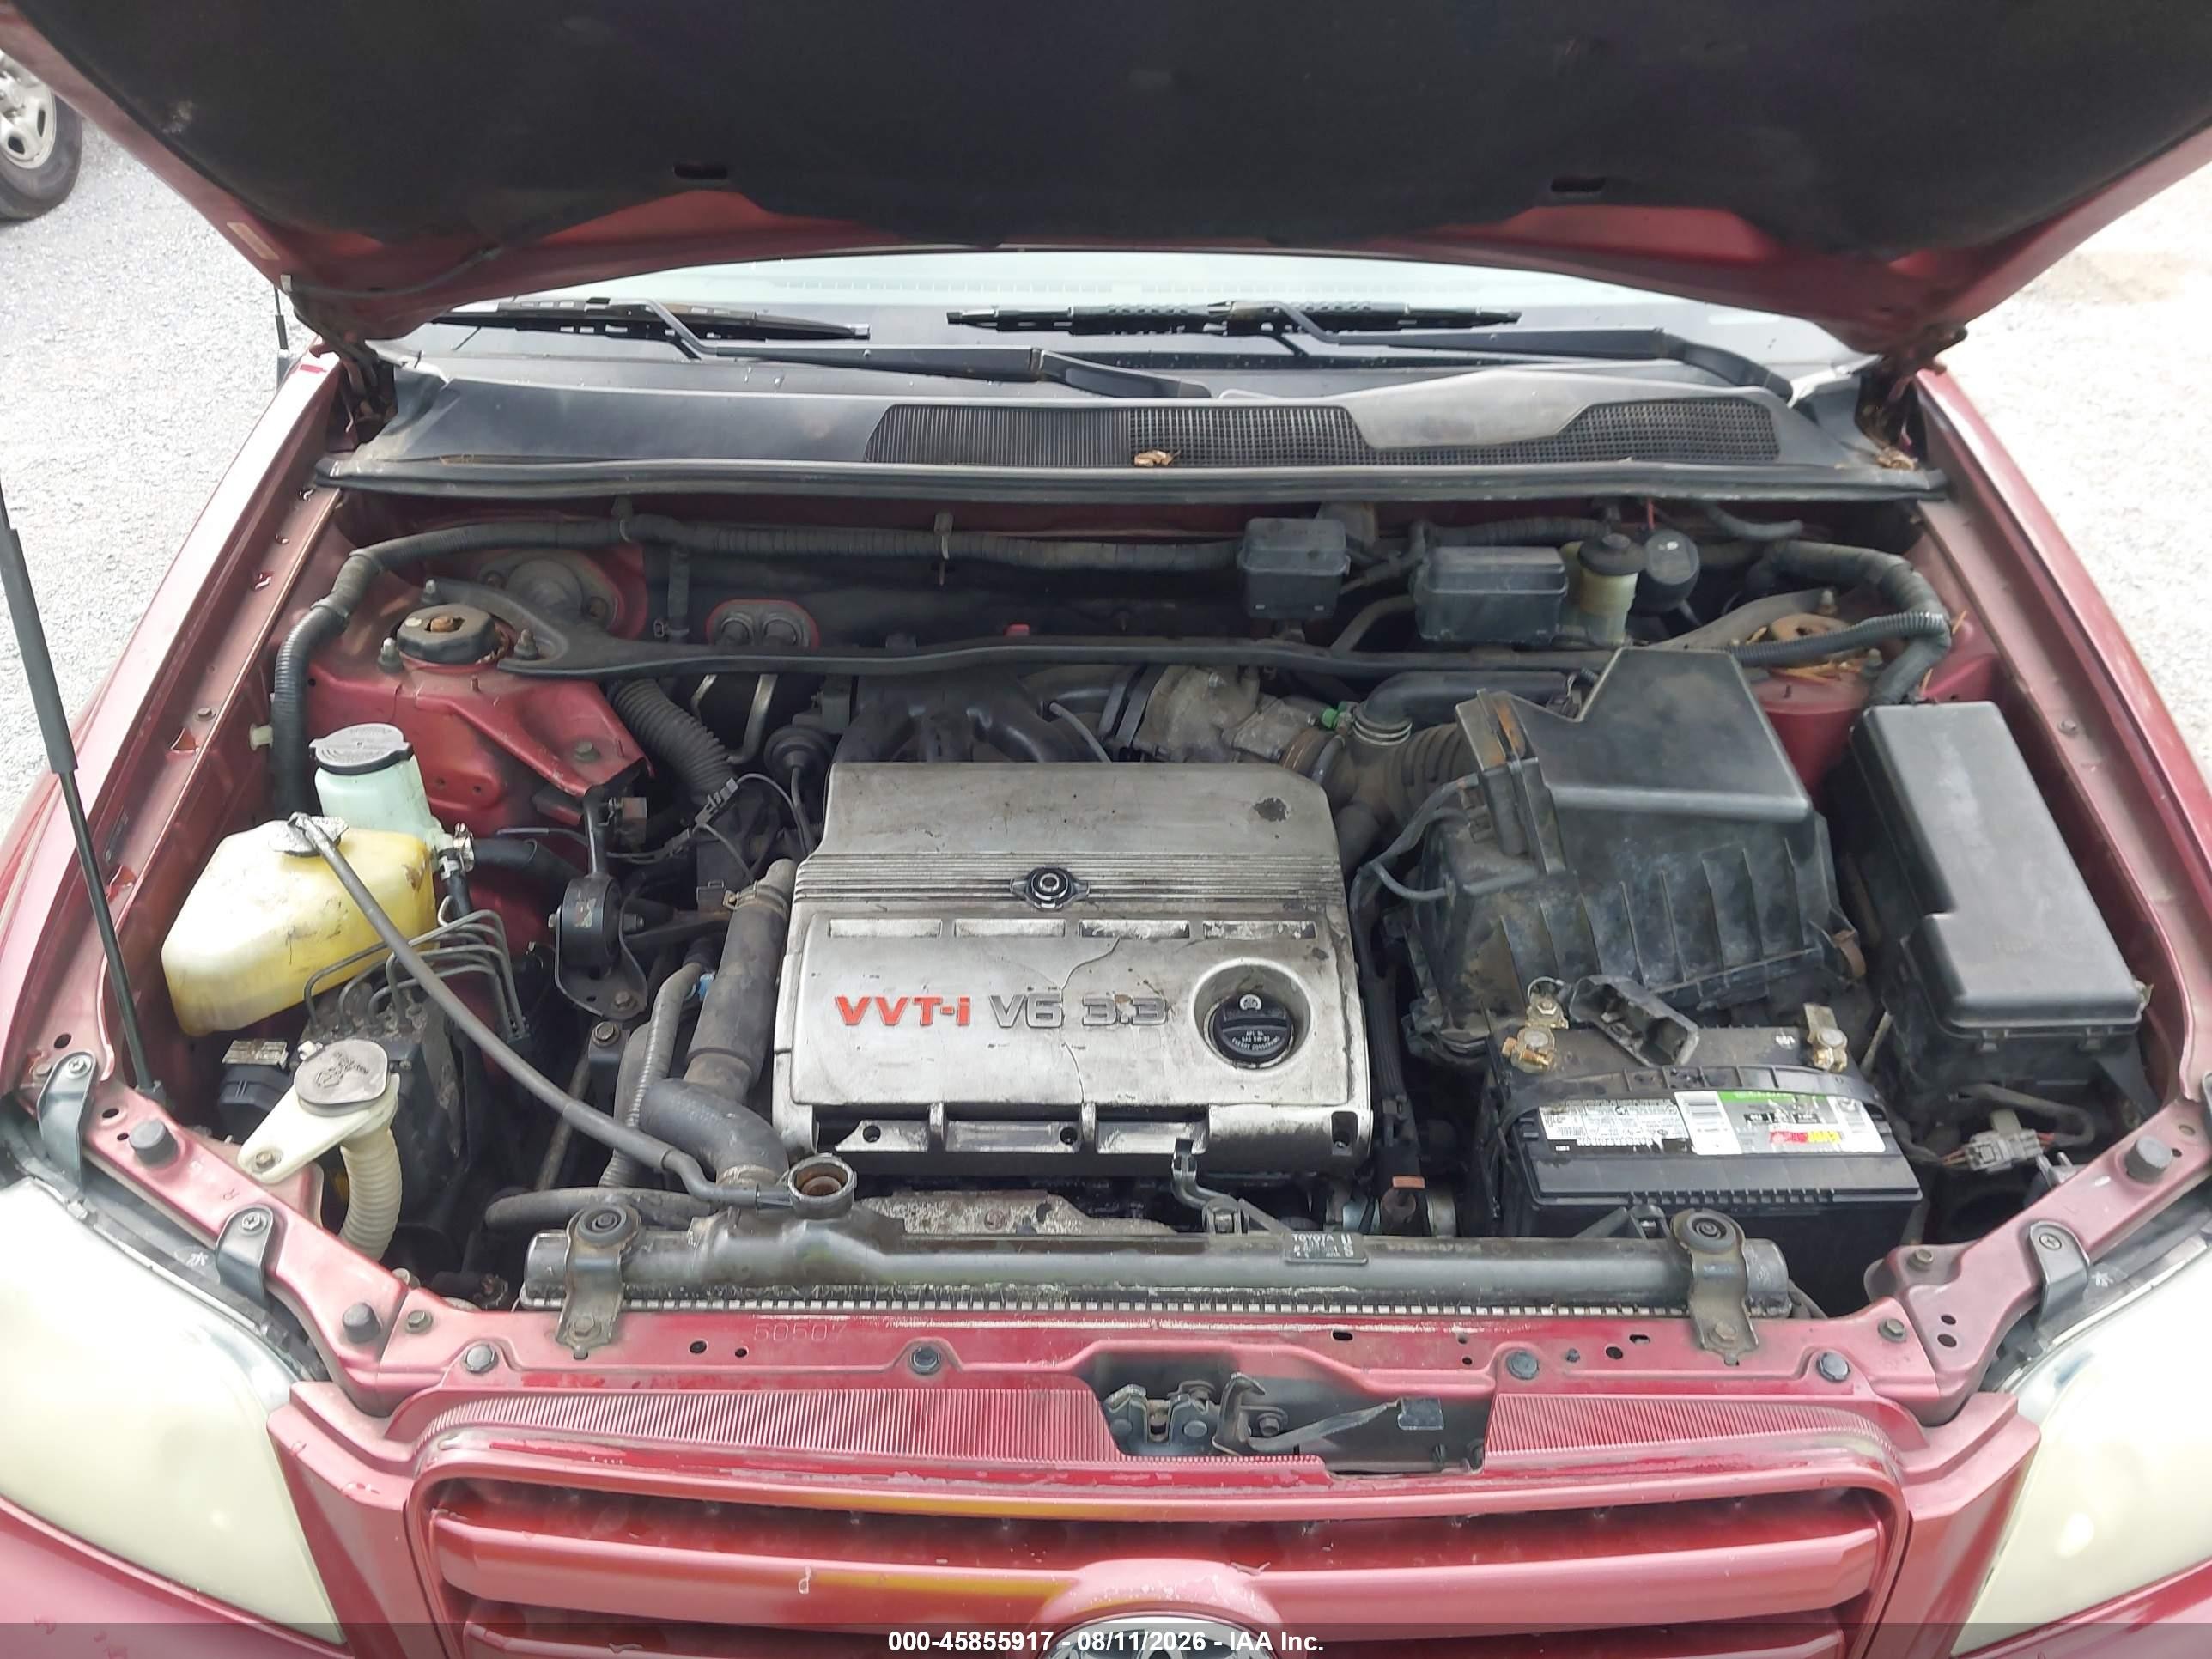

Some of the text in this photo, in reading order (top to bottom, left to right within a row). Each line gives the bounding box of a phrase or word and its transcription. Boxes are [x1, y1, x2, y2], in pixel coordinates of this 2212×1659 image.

[836, 994, 1167, 1028] VVT-i V6 3.3
[1291, 1233, 1334, 1243] TOYOTA
